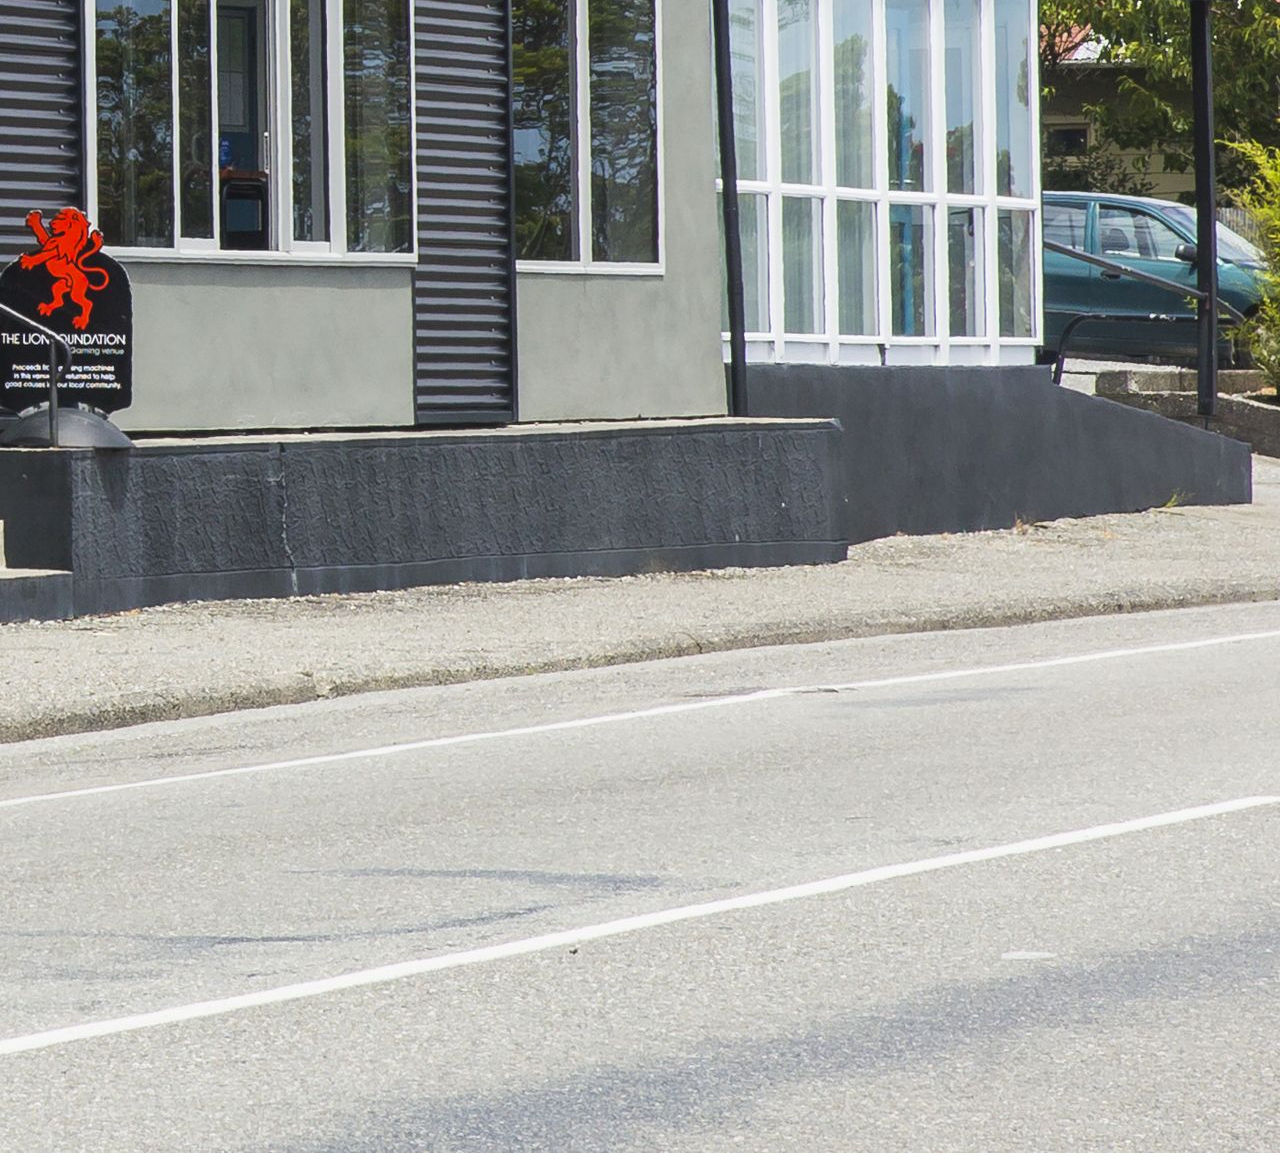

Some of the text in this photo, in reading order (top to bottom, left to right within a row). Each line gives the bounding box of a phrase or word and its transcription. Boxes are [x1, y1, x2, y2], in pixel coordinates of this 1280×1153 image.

[1, 333, 126, 345] THE LION OUNDATION
[100, 373, 116, 381] help
[5, 381, 22, 389] good
[68, 381, 85, 389] local
